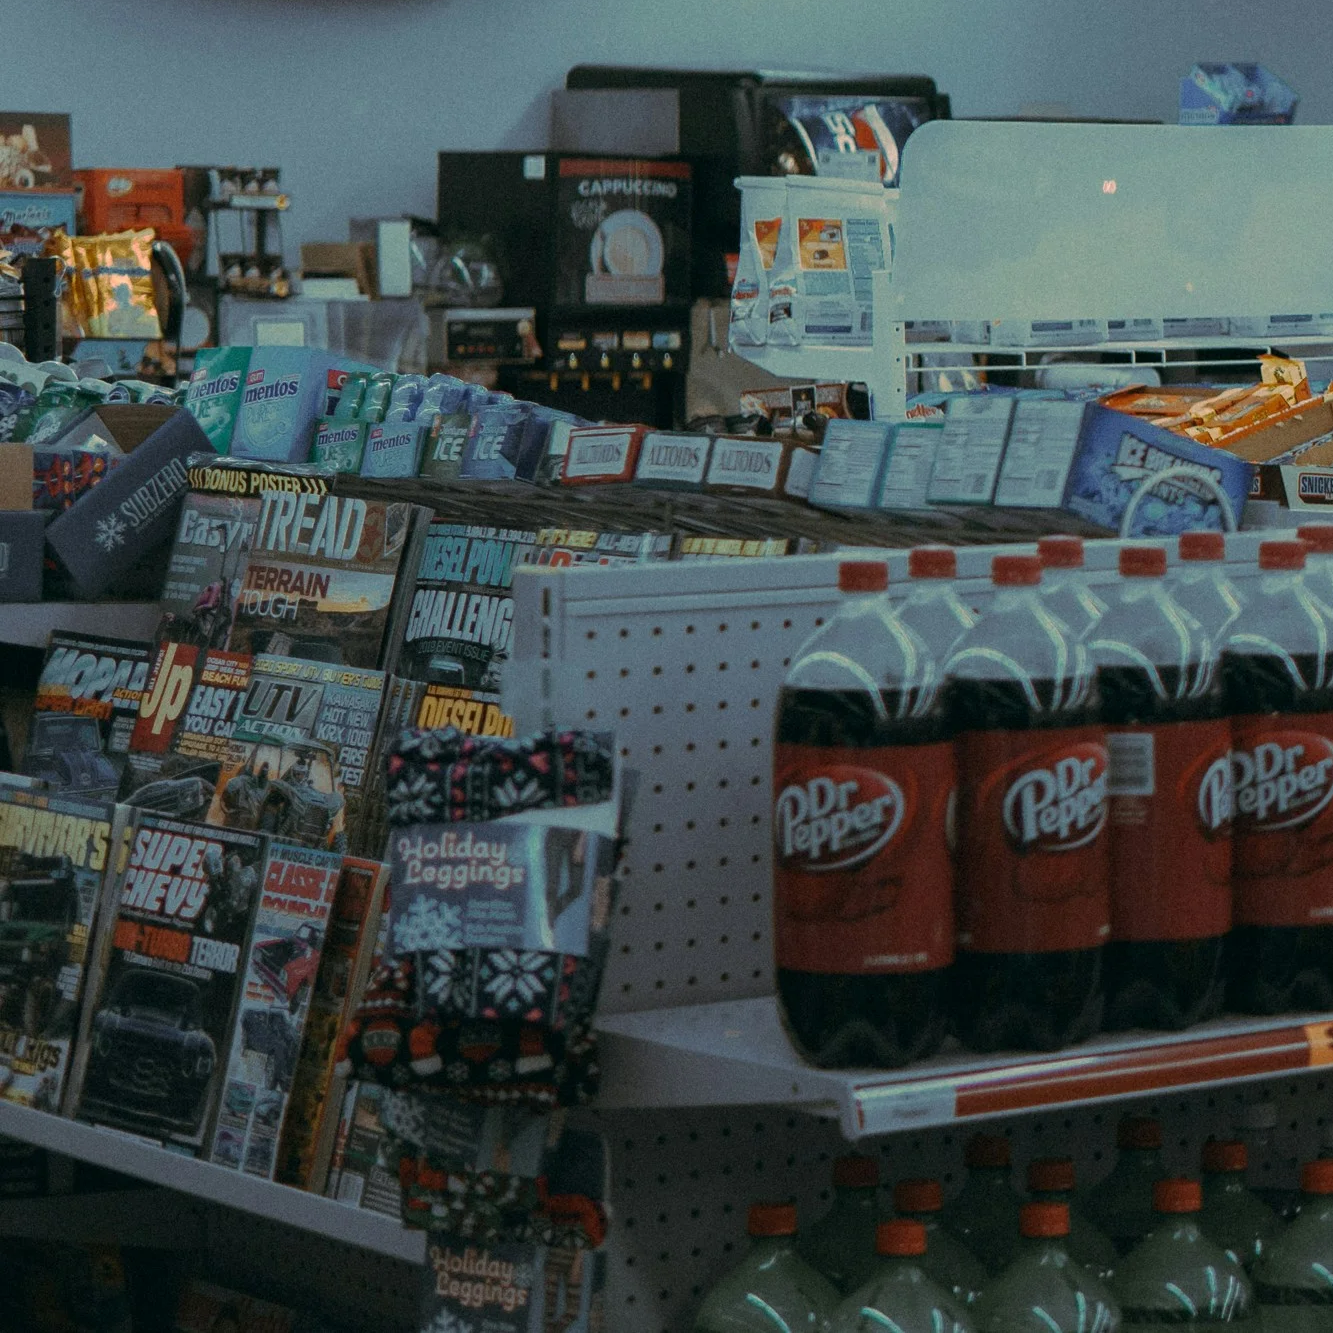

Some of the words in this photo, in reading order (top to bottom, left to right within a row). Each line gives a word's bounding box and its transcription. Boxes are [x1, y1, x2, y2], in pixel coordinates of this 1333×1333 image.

[577, 178, 678, 199] CAPPUCCINO
[187, 376, 240, 400] mentos
[243, 378, 299, 405] mentos
[317, 427, 359, 446] mentos
[371, 433, 412, 454] mentos
[432, 435, 463, 461] ICE
[472, 435, 502, 461] ICE
[576, 442, 622, 466] ALTOIDS
[647, 443, 701, 468] ALTOIDS
[719, 446, 772, 474] ALTOIDS
[120, 457, 189, 528] SUBZERO
[203, 468, 248, 494] BONUS
[249, 472, 301, 495] POSTER
[256, 490, 366, 562] TREAD
[249, 566, 331, 599] TERRAIN
[242, 589, 300, 620] TOUGH
[436, 641, 465, 657] EVENT
[463, 643, 490, 663] ISSUE
[201, 670, 230, 684] BEACH
[275, 660, 301, 677] SPORT
[190, 685, 238, 719] EASY
[243, 678, 319, 725] UTV
[184, 715, 212, 733] YOU
[236, 719, 309, 742] ACTION
[321, 707, 346, 725] HOT
[349, 712, 371, 729] NEW
[316, 723, 344, 743] KRX
[345, 728, 373, 747] 1000
[338, 746, 369, 766] FIRST
[1261, 742, 1305, 771] Dr
[340, 767, 366, 786] TEST
[1056, 755, 1097, 790] Dr
[810, 776, 857, 809] Dr
[776, 784, 893, 858] Pepper
[131, 828, 225, 880] SUPER
[281, 848, 313, 866] MUSCLE
[399, 831, 508, 866] Holiday
[402, 860, 526, 890] Leggings
[429, 1245, 515, 1288] Holiday
[434, 1270, 529, 1313] Leggings
